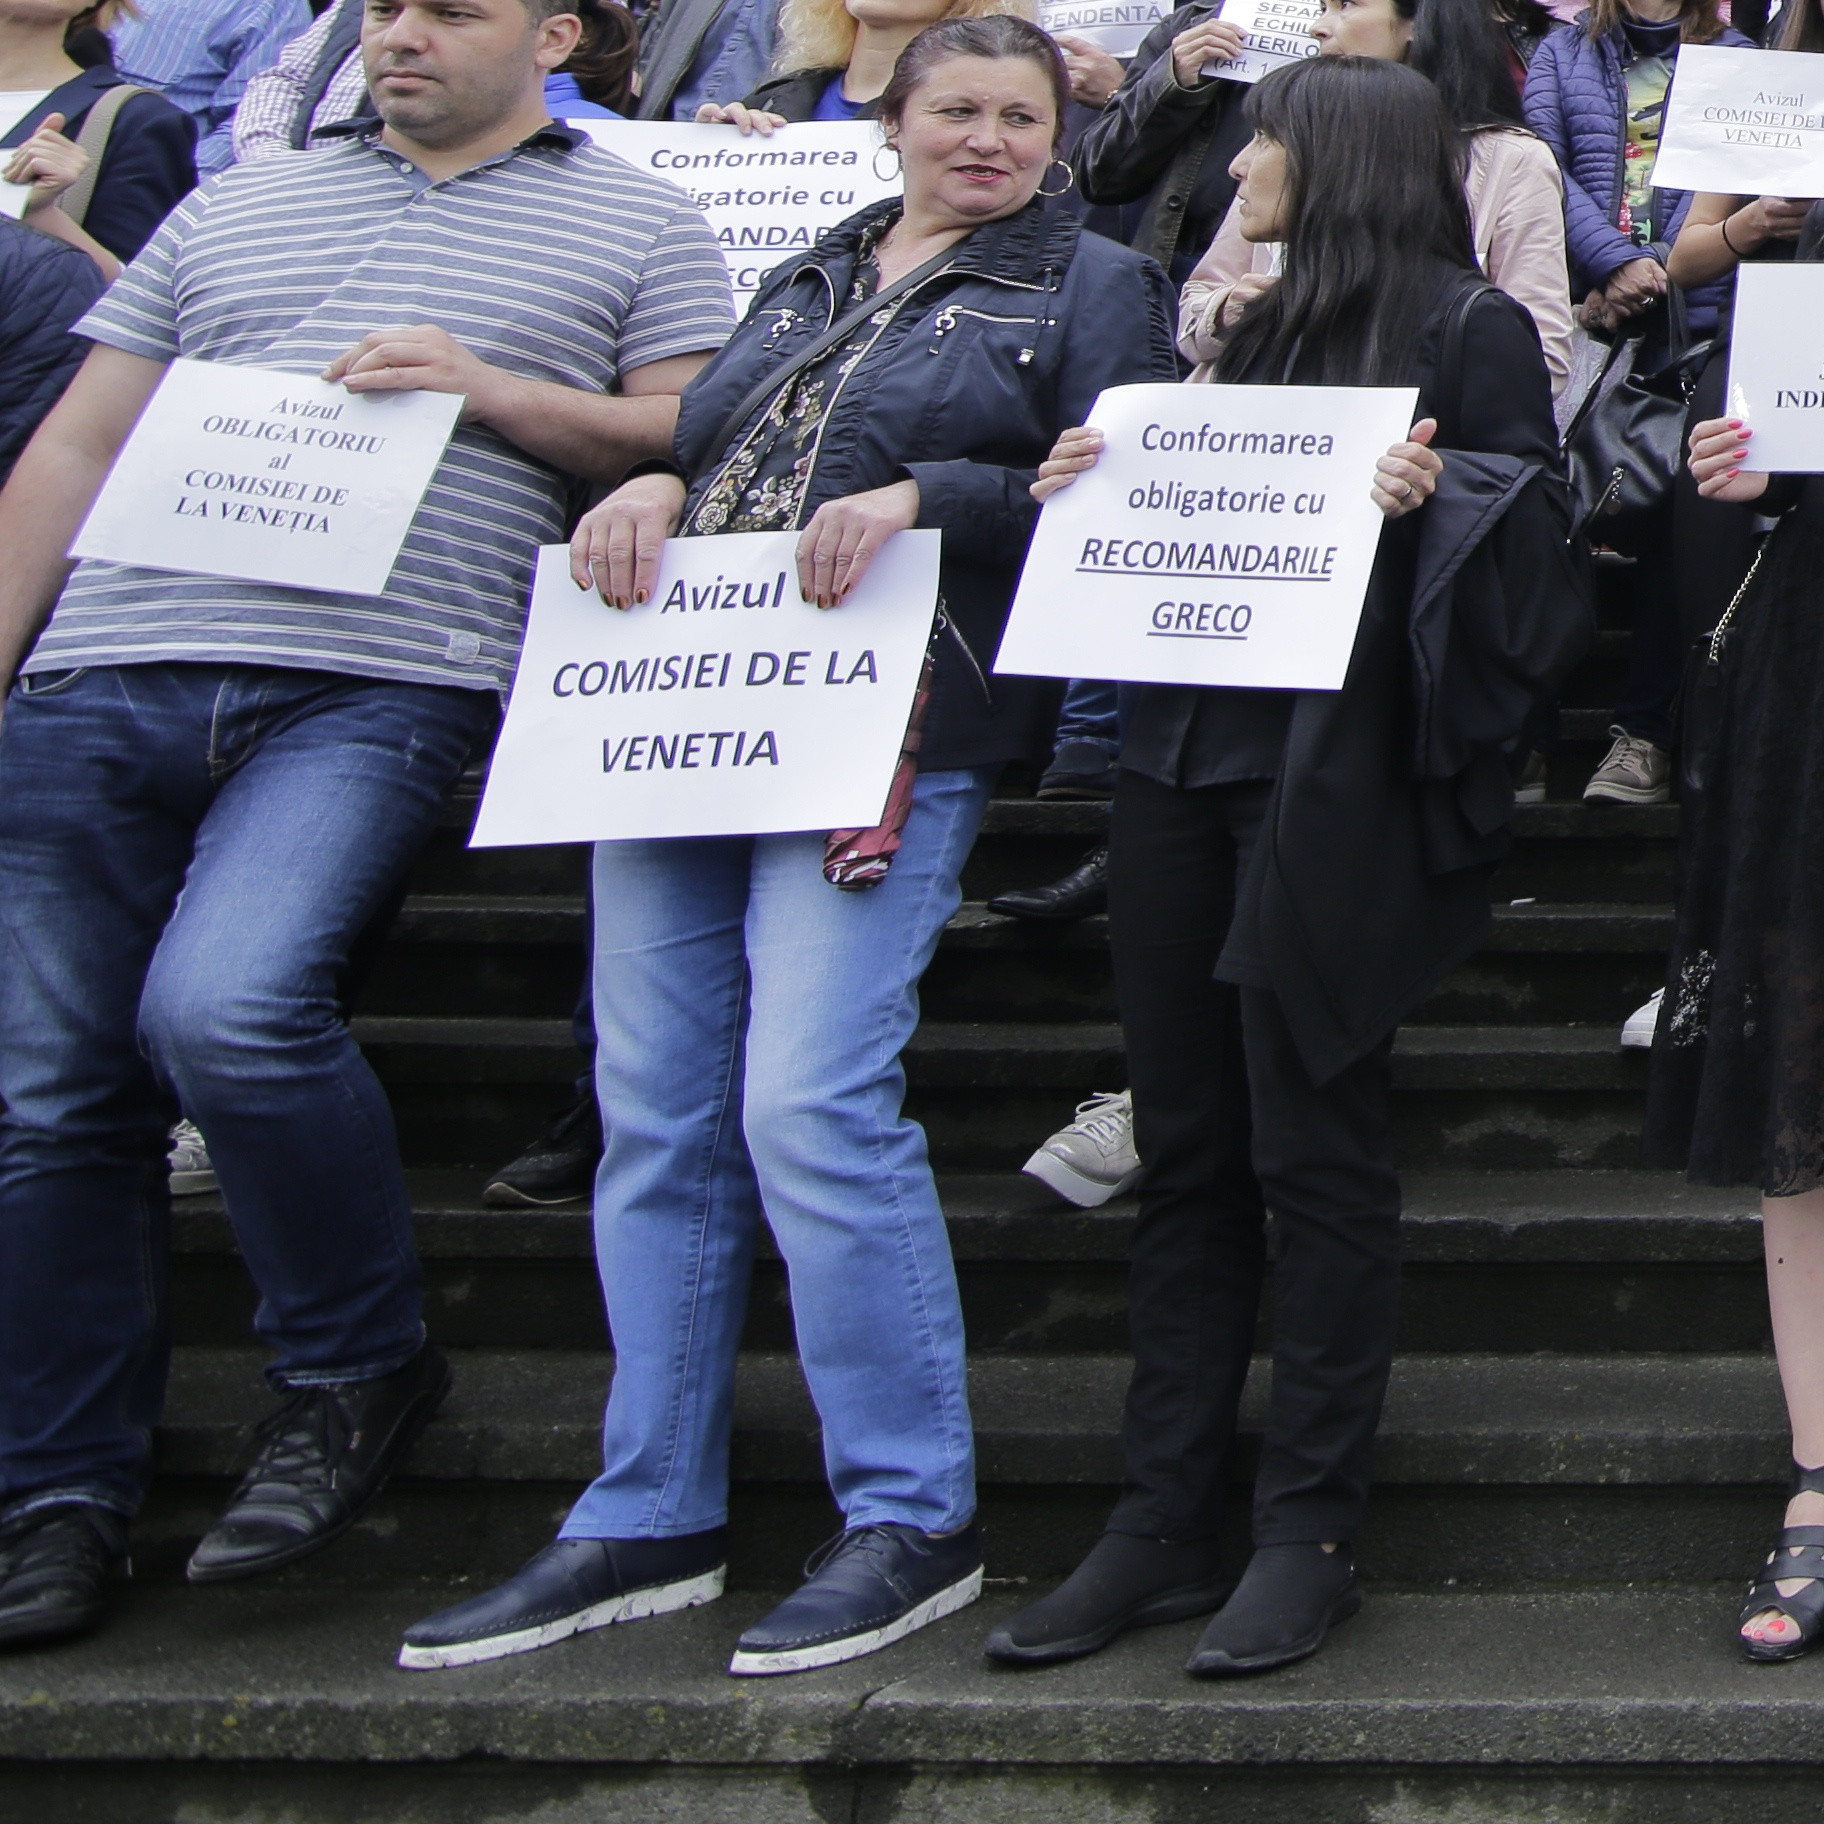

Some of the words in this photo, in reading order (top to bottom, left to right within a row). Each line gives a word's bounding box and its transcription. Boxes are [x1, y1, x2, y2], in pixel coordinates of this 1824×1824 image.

[1041, 2, 1163, 29] PENDENTĂ
[1257, 2, 1324, 18] SEPAR
[1253, 18, 1311, 34] ECHIL
[1248, 33, 1321, 58] TERILO
[1753, 92, 1804, 107] Avizul
[1703, 107, 1787, 126] COMISIEI
[1792, 114, 1815, 128] DE
[650, 149, 858, 169] Conformarea
[689, 185, 810, 211] igatorie
[819, 190, 855, 205] cu
[270, 397, 344, 420] Avizul
[203, 415, 388, 454] OBLIGATORIU
[1141, 423, 1334, 456] Conformarea
[268, 454, 292, 470] al
[185, 469, 305, 501] COMISIEI
[311, 485, 349, 506] DE
[1128, 481, 1285, 517] obligatorie
[1293, 494, 1325, 515] cu
[173, 496, 209, 517] LA
[1080, 538, 1338, 575] RECOMANDARILE
[661, 571, 787, 614] Avizul
[1151, 601, 1253, 633] GRECO
[552, 652, 731, 697] COMISIEI
[745, 650, 811, 687] DE
[824, 649, 878, 684] LA
[601, 730, 779, 773] VENETIA
